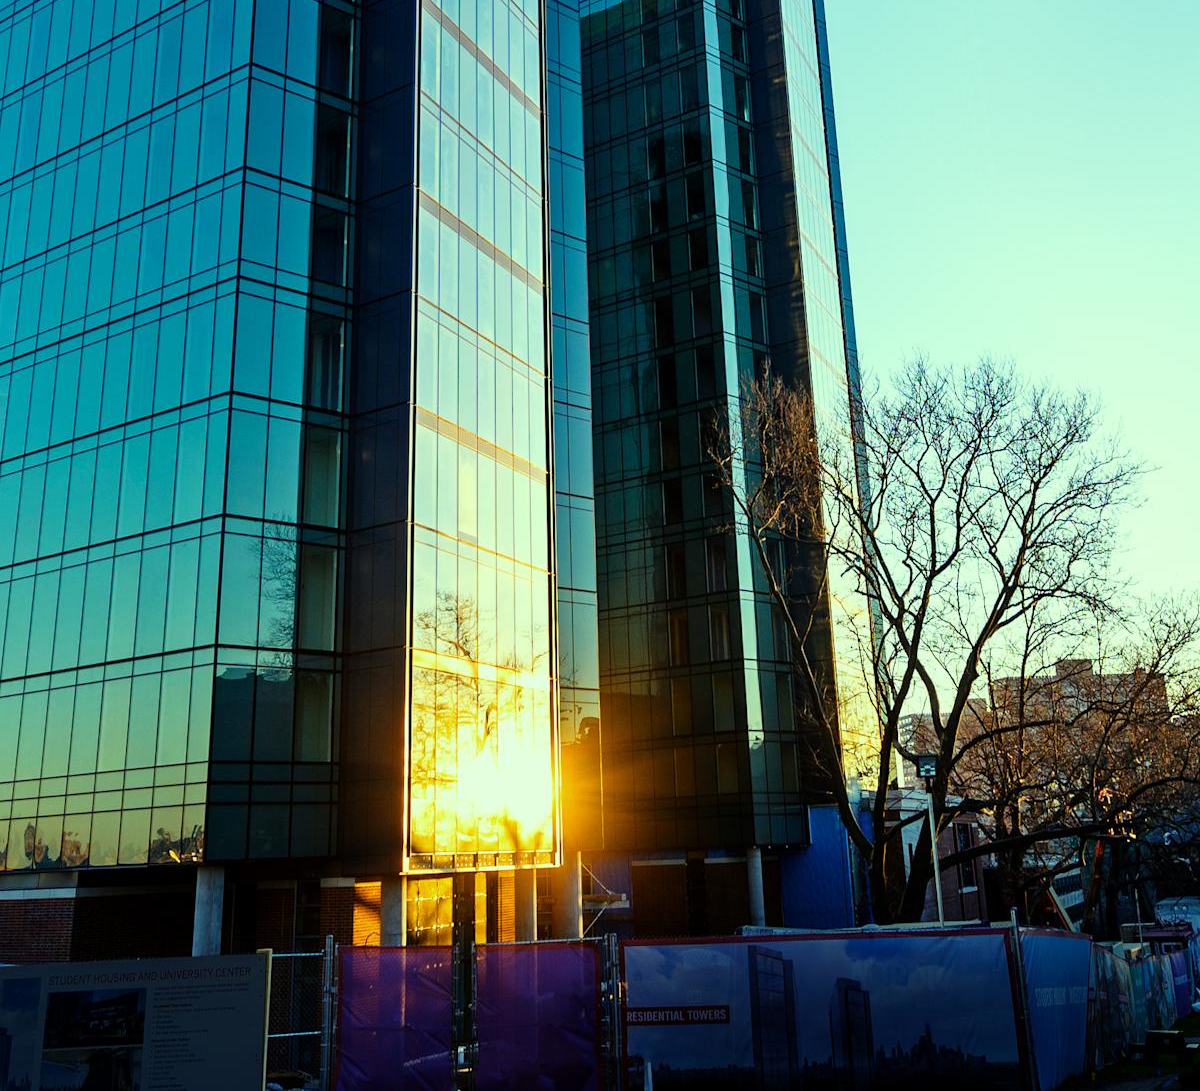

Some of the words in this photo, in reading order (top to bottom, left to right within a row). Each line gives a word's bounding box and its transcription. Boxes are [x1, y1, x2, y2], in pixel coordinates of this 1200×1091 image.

[47, 973, 93, 986] STUDENT
[94, 971, 136, 984] HOUSING
[136, 971, 159, 983] AND
[160, 969, 214, 982] UNIVERSITY
[215, 966, 252, 979] CENTER
[626, 1010, 685, 1022] RESIDENTIAL
[687, 1009, 727, 1021] TOWERS
